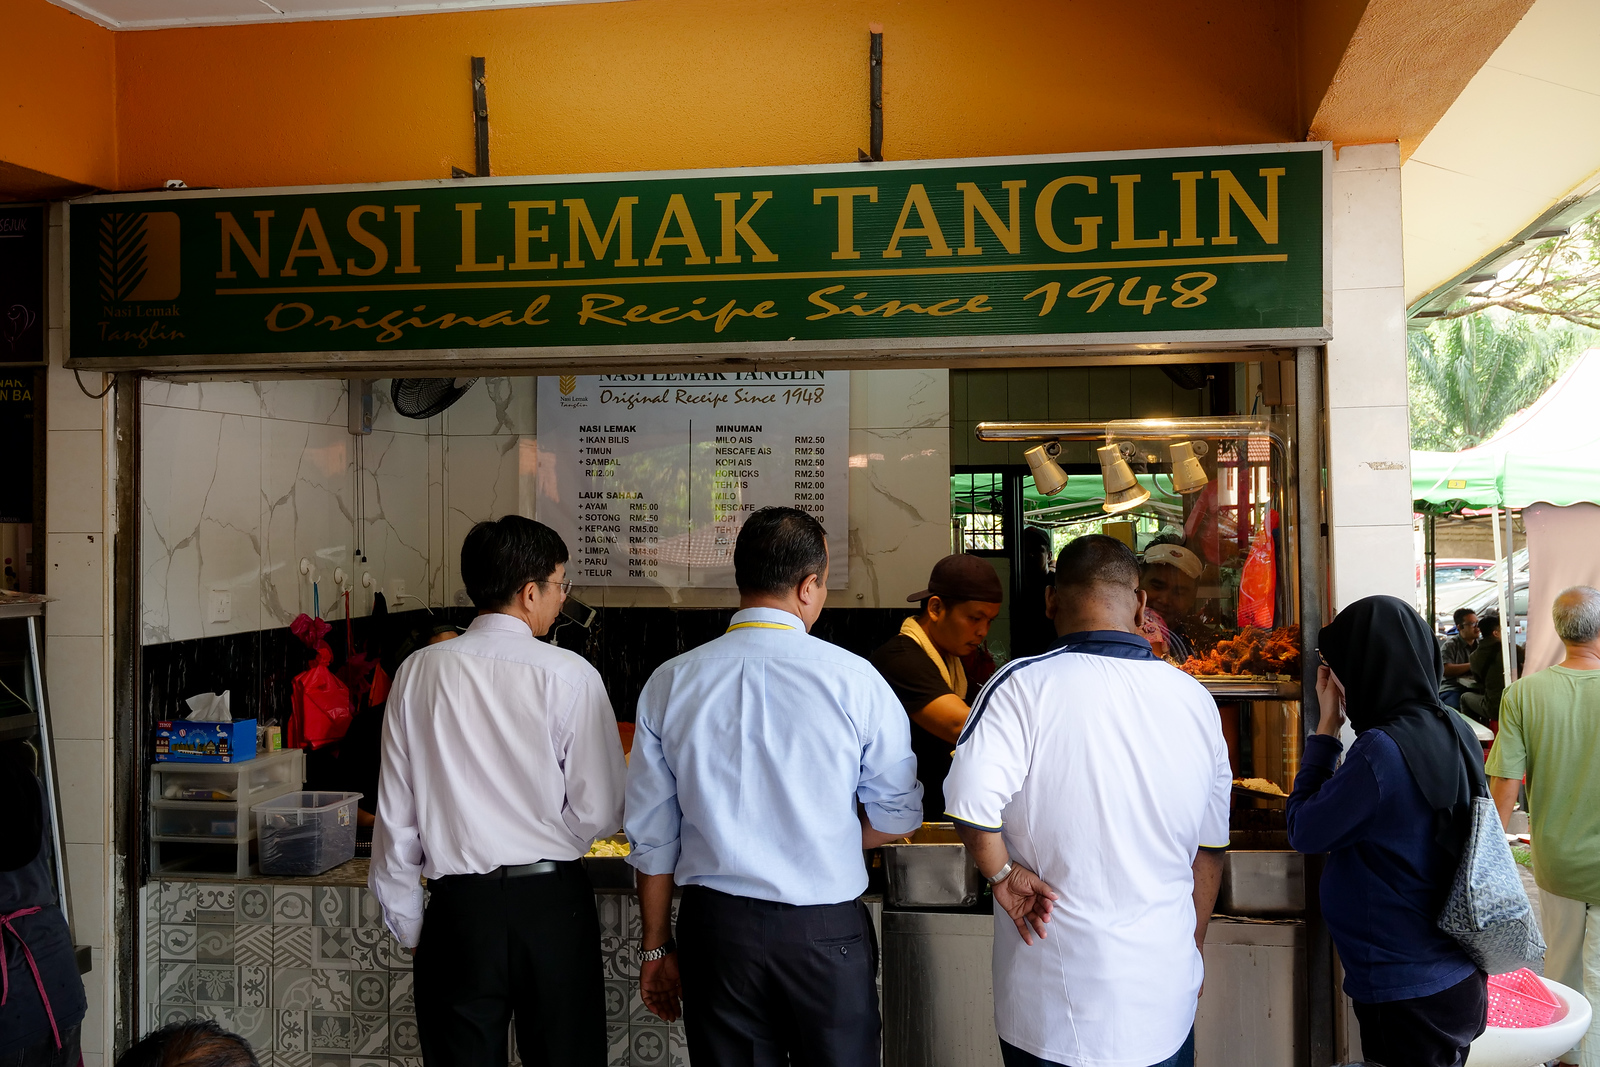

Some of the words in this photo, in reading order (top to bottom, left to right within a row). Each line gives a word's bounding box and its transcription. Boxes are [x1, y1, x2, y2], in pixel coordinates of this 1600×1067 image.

[215, 204, 421, 278] NASI
[455, 190, 778, 272] LEMAK
[813, 167, 1286, 260] TANGLIN
[103, 305, 132, 318] Nasi
[136, 304, 180, 316] Lemak
[264, 294, 550, 342] Original
[577, 293, 778, 333] Recipe
[806, 284, 993, 320] Since
[1023, 271, 1218, 317] 1948
[97, 320, 186, 349] Tanglin
[600, 388, 670, 410] Original
[675, 389, 728, 408] Receipe
[734, 388, 776, 404] Since
[782, 387, 824, 406] 1948
